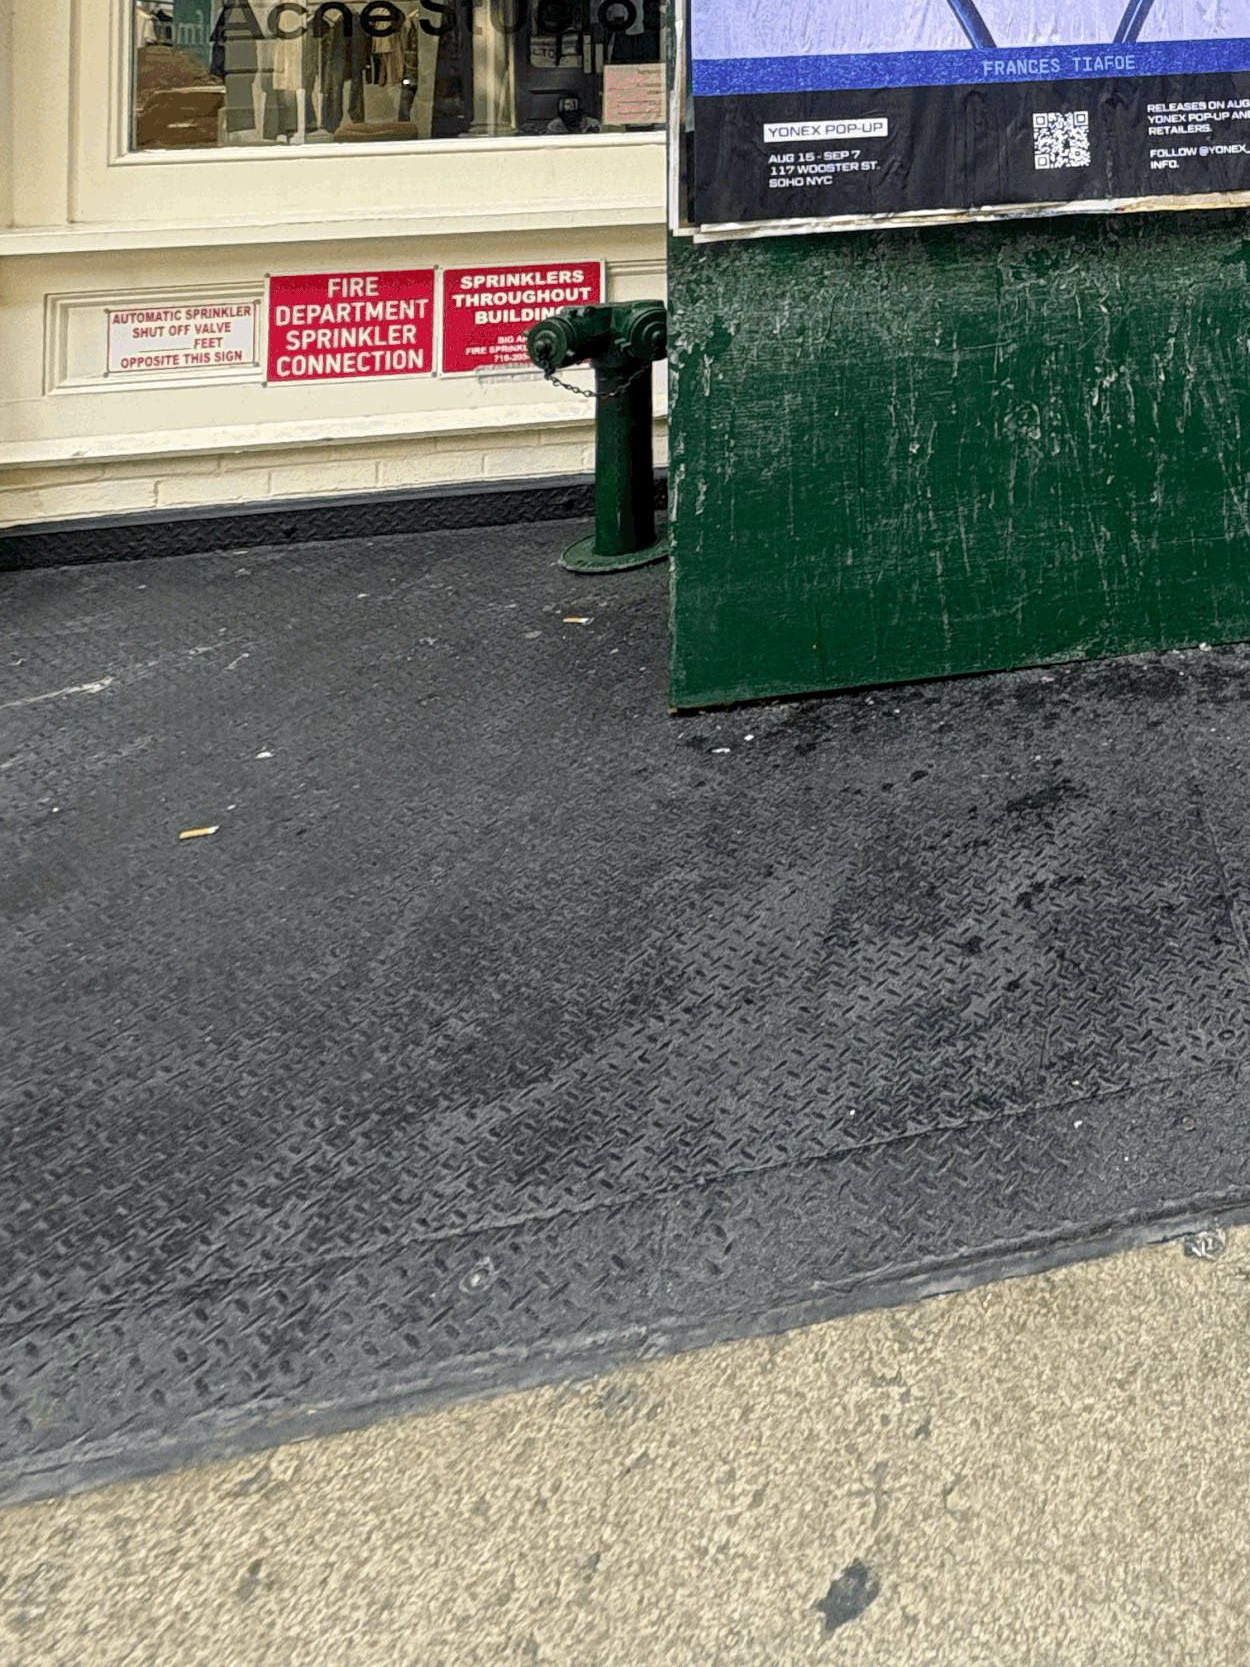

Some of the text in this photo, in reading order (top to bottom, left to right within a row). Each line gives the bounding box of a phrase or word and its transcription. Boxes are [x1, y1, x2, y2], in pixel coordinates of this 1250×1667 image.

[983, 55, 1136, 75] FRANCES TIAFOE
[1147, 101, 1207, 113] RELEASES
[1208, 101, 1225, 111] ON
[1147, 114, 1187, 124] YONEX
[1188, 111, 1230, 123] POP-UP
[769, 122, 883, 138] YONEX POP-UP
[1149, 124, 1212, 136] RETAILERS.
[768, 153, 794, 164] AUG
[799, 152, 814, 162] 15
[824, 151, 849, 161] SEP
[851, 150, 861, 160] 7
[1150, 147, 1198, 159] FOLLOW
[770, 161, 881, 176] 117 WOOSTER ST.
[1150, 160, 1180, 170] INFO.
[769, 176, 833, 188] SOHO NYC
[460, 269, 584, 290] SPRINKLERS
[327, 276, 379, 299] FIRE
[452, 286, 592, 308] THROUGHOUT
[112, 305, 251, 325] AUTOMATIC SPRINKLER
[275, 298, 429, 327] DEPARTMENT
[132, 321, 231, 338] SHUT OFF VALVE
[193, 336, 223, 349] FEET
[286, 324, 416, 351] SPRINKLER
[497, 335, 515, 344] BIG
[465, 346, 487, 355] FIRE
[120, 350, 242, 368] OPPOSITE THIS SIGN
[276, 348, 423, 377] CONNECTION
